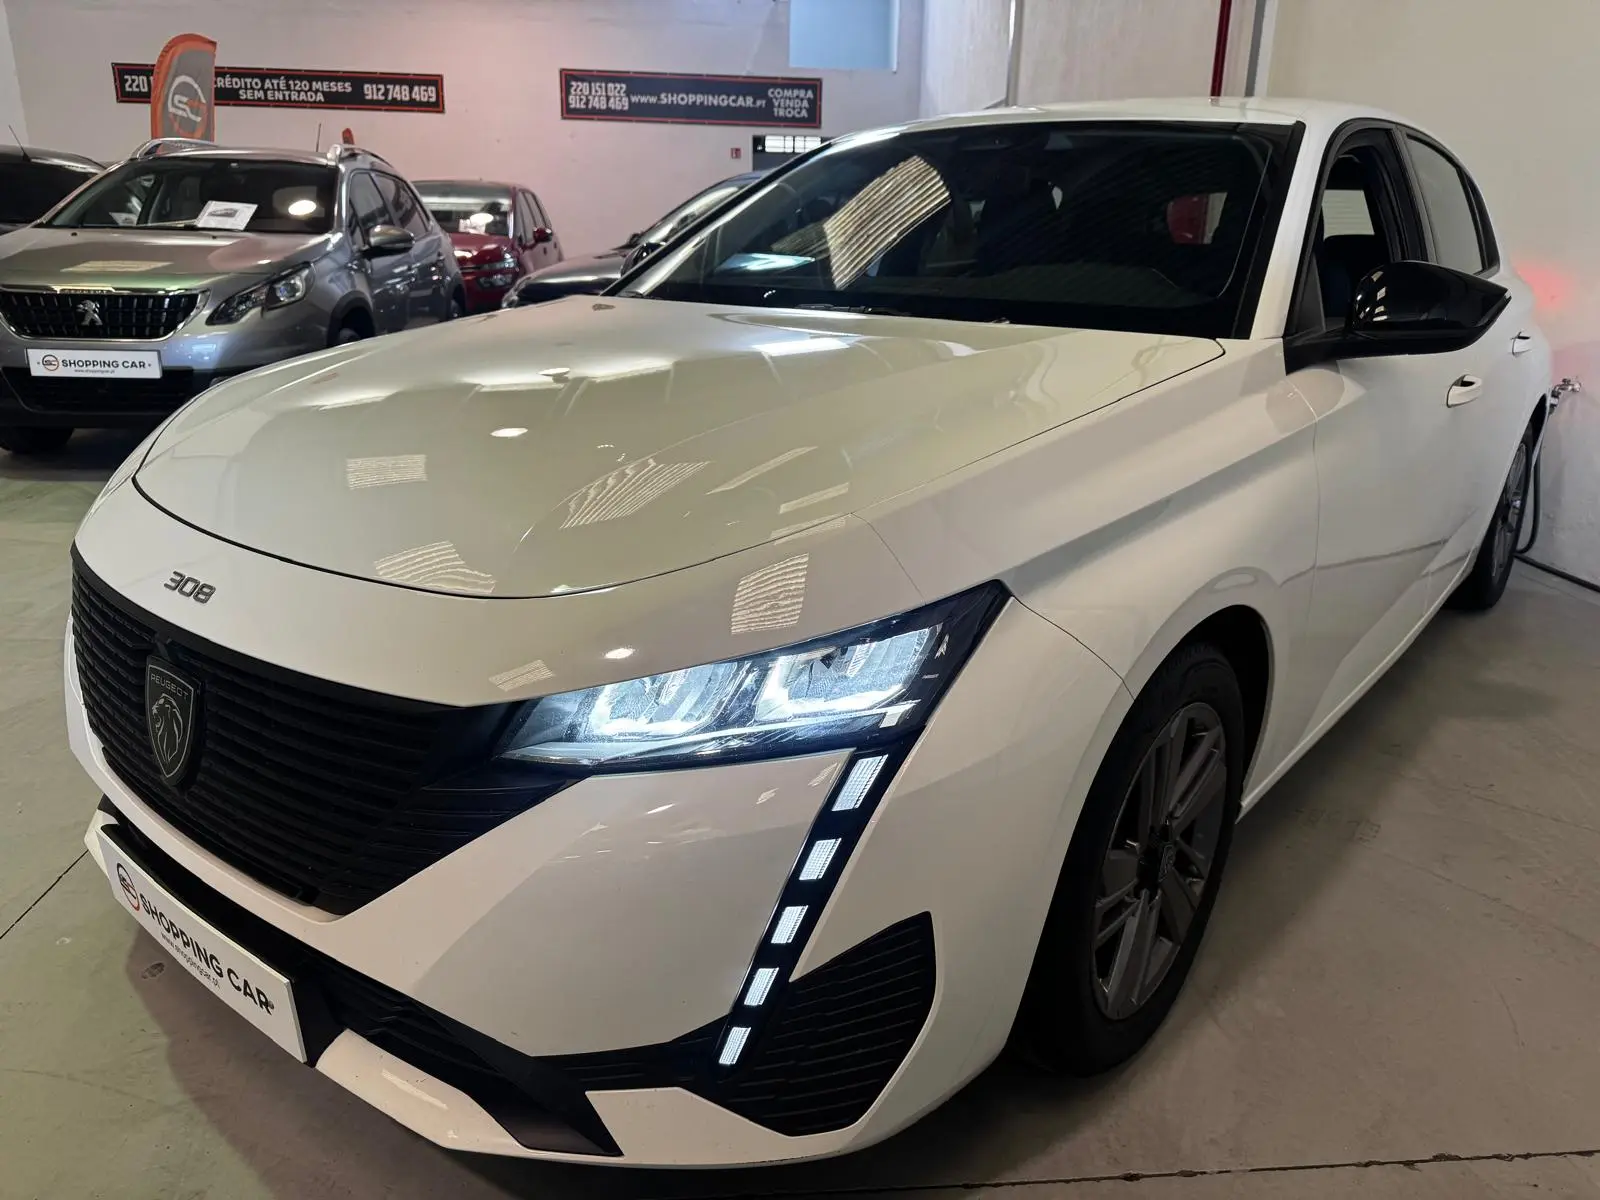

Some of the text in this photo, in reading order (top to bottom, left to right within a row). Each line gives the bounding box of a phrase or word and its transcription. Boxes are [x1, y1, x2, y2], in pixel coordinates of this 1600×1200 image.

[124, 75, 149, 93] 220
[264, 76, 287, 90] ATÉ
[289, 80, 310, 91] 120
[312, 81, 352, 93] MESES
[570, 81, 627, 97] 220 151 022
[239, 89, 325, 102] SEM ENTRADA
[363, 83, 436, 102] 912 748 469
[768, 88, 814, 99] COMPRA
[568, 95, 629, 111] 912 748 469
[772, 98, 810, 109] VENDA
[773, 107, 808, 118] TROCA
[61, 359, 146, 369] SHOPPING CAR
[163, 571, 216, 604] 308
[150, 673, 189, 700] PEUGEOT
[139, 893, 273, 1016] SHOPPING CAR
